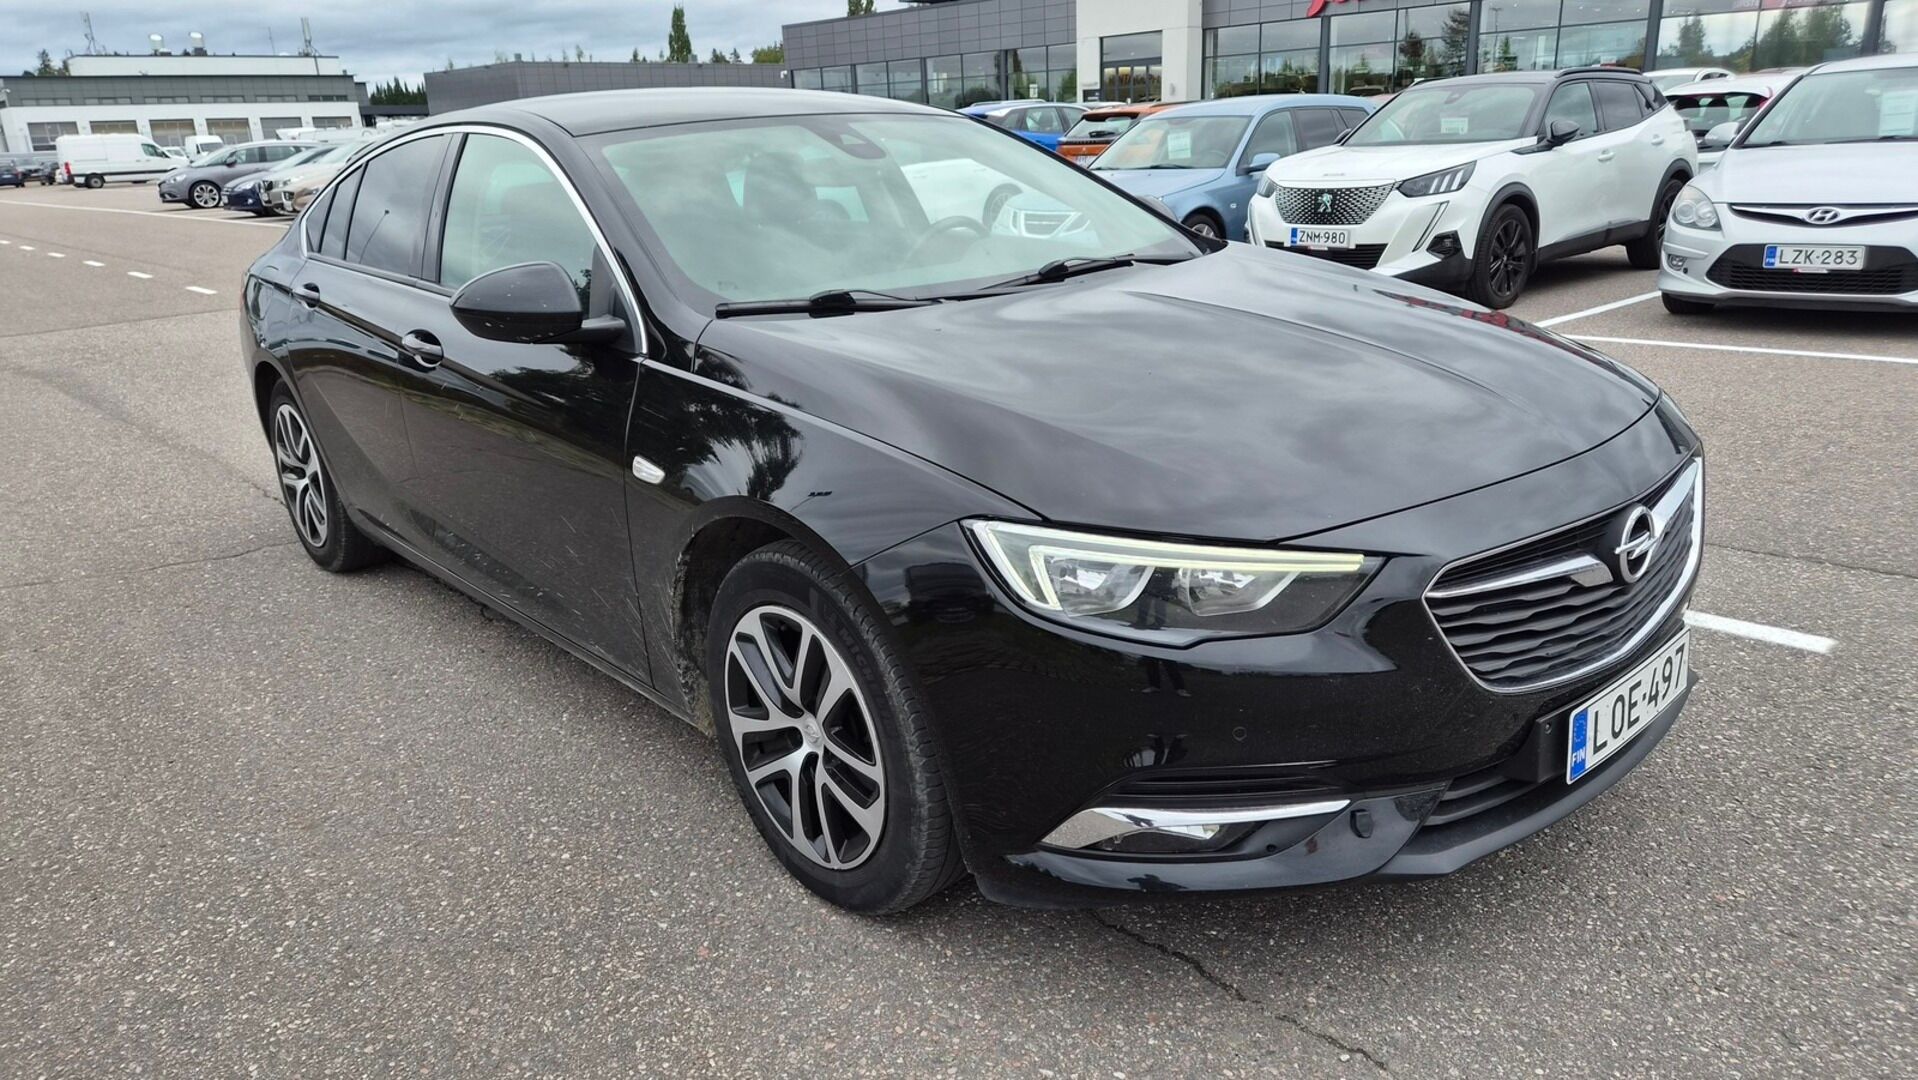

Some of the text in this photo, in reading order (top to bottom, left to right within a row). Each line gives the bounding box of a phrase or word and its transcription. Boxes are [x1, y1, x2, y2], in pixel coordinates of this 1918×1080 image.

[1299, 230, 1346, 244] ZNM-980
[1779, 249, 1858, 265] LZK-283
[1592, 642, 1686, 756] LOE-497
[1572, 746, 1586, 767] FIN
